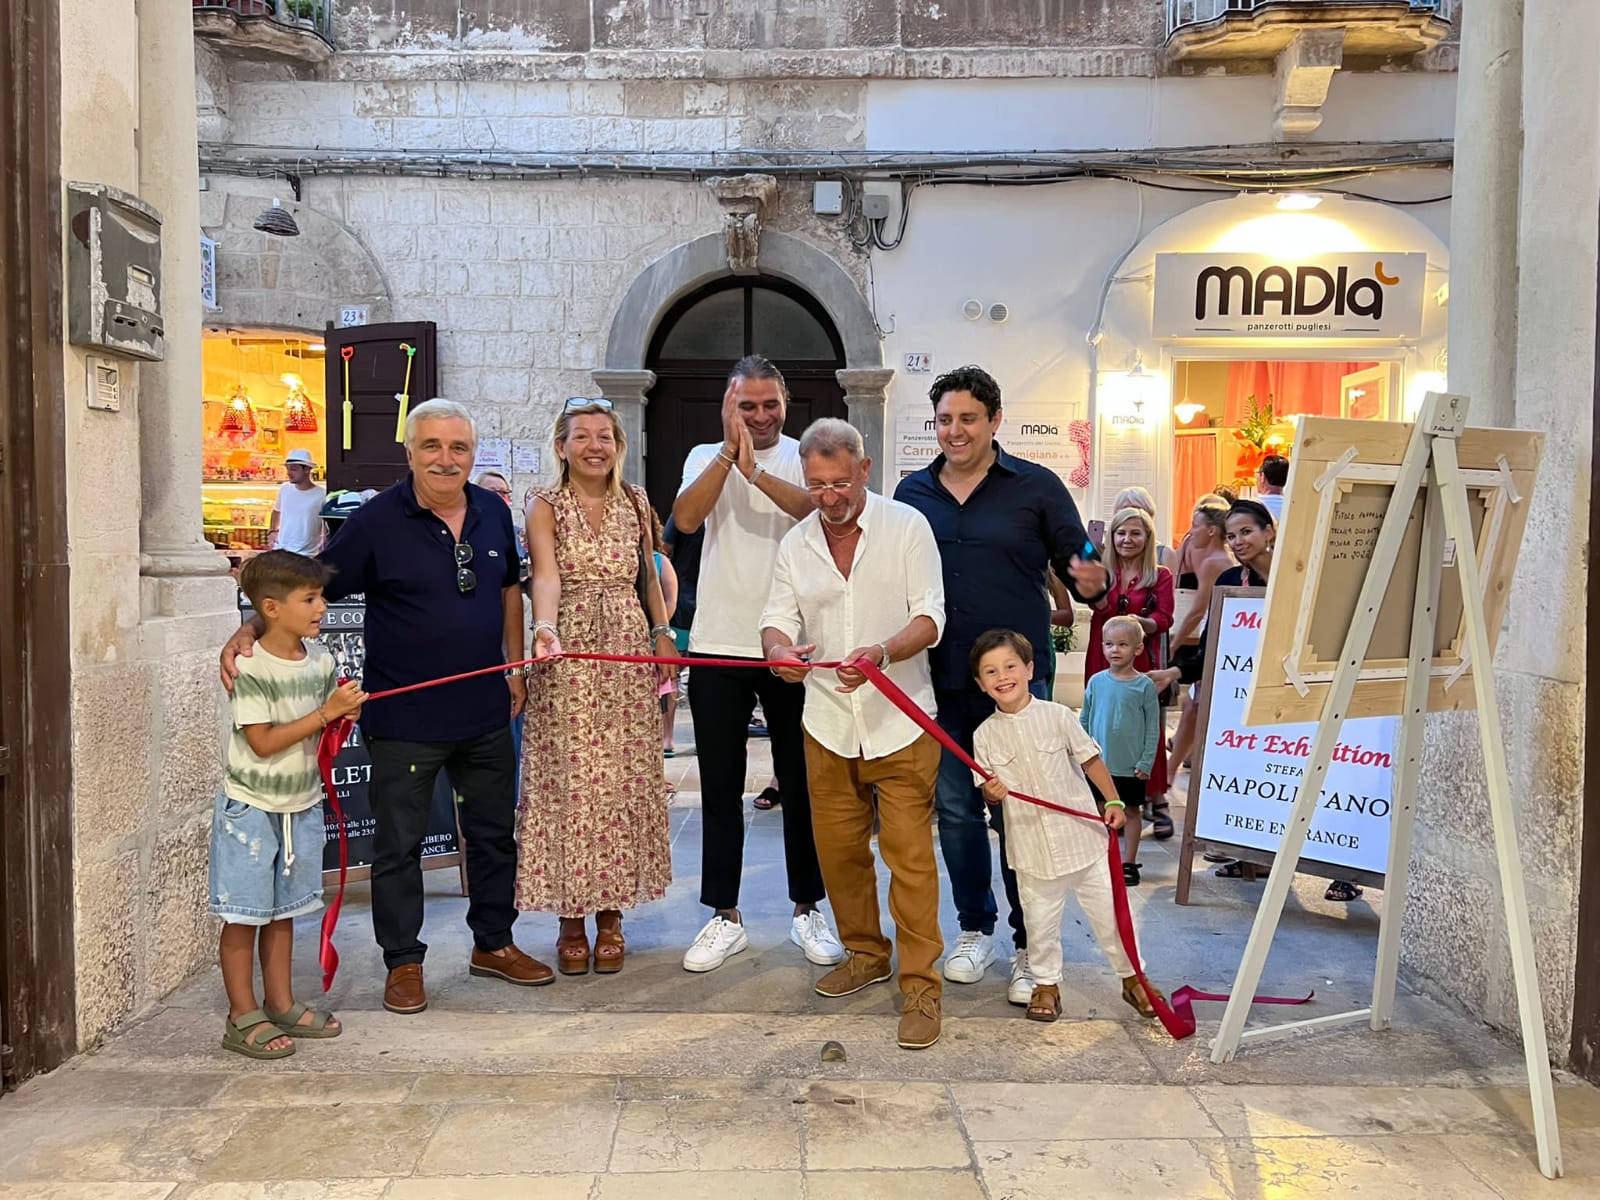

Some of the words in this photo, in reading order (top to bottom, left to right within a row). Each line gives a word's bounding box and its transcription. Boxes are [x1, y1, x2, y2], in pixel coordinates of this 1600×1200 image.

[344, 311, 356, 322] 23
[1247, 323, 1294, 331] panzerotti
[1296, 322, 1331, 331] pugliesi
[907, 355, 921, 367] 21
[902, 444, 943, 457] Carne
[1215, 729, 1258, 750] Art
[1263, 735, 1392, 768] Exhition
[1205, 773, 1390, 817] NAPOLIANO
[1224, 813, 1265, 832] FREE
[1269, 821, 1359, 849] ENRANCE
